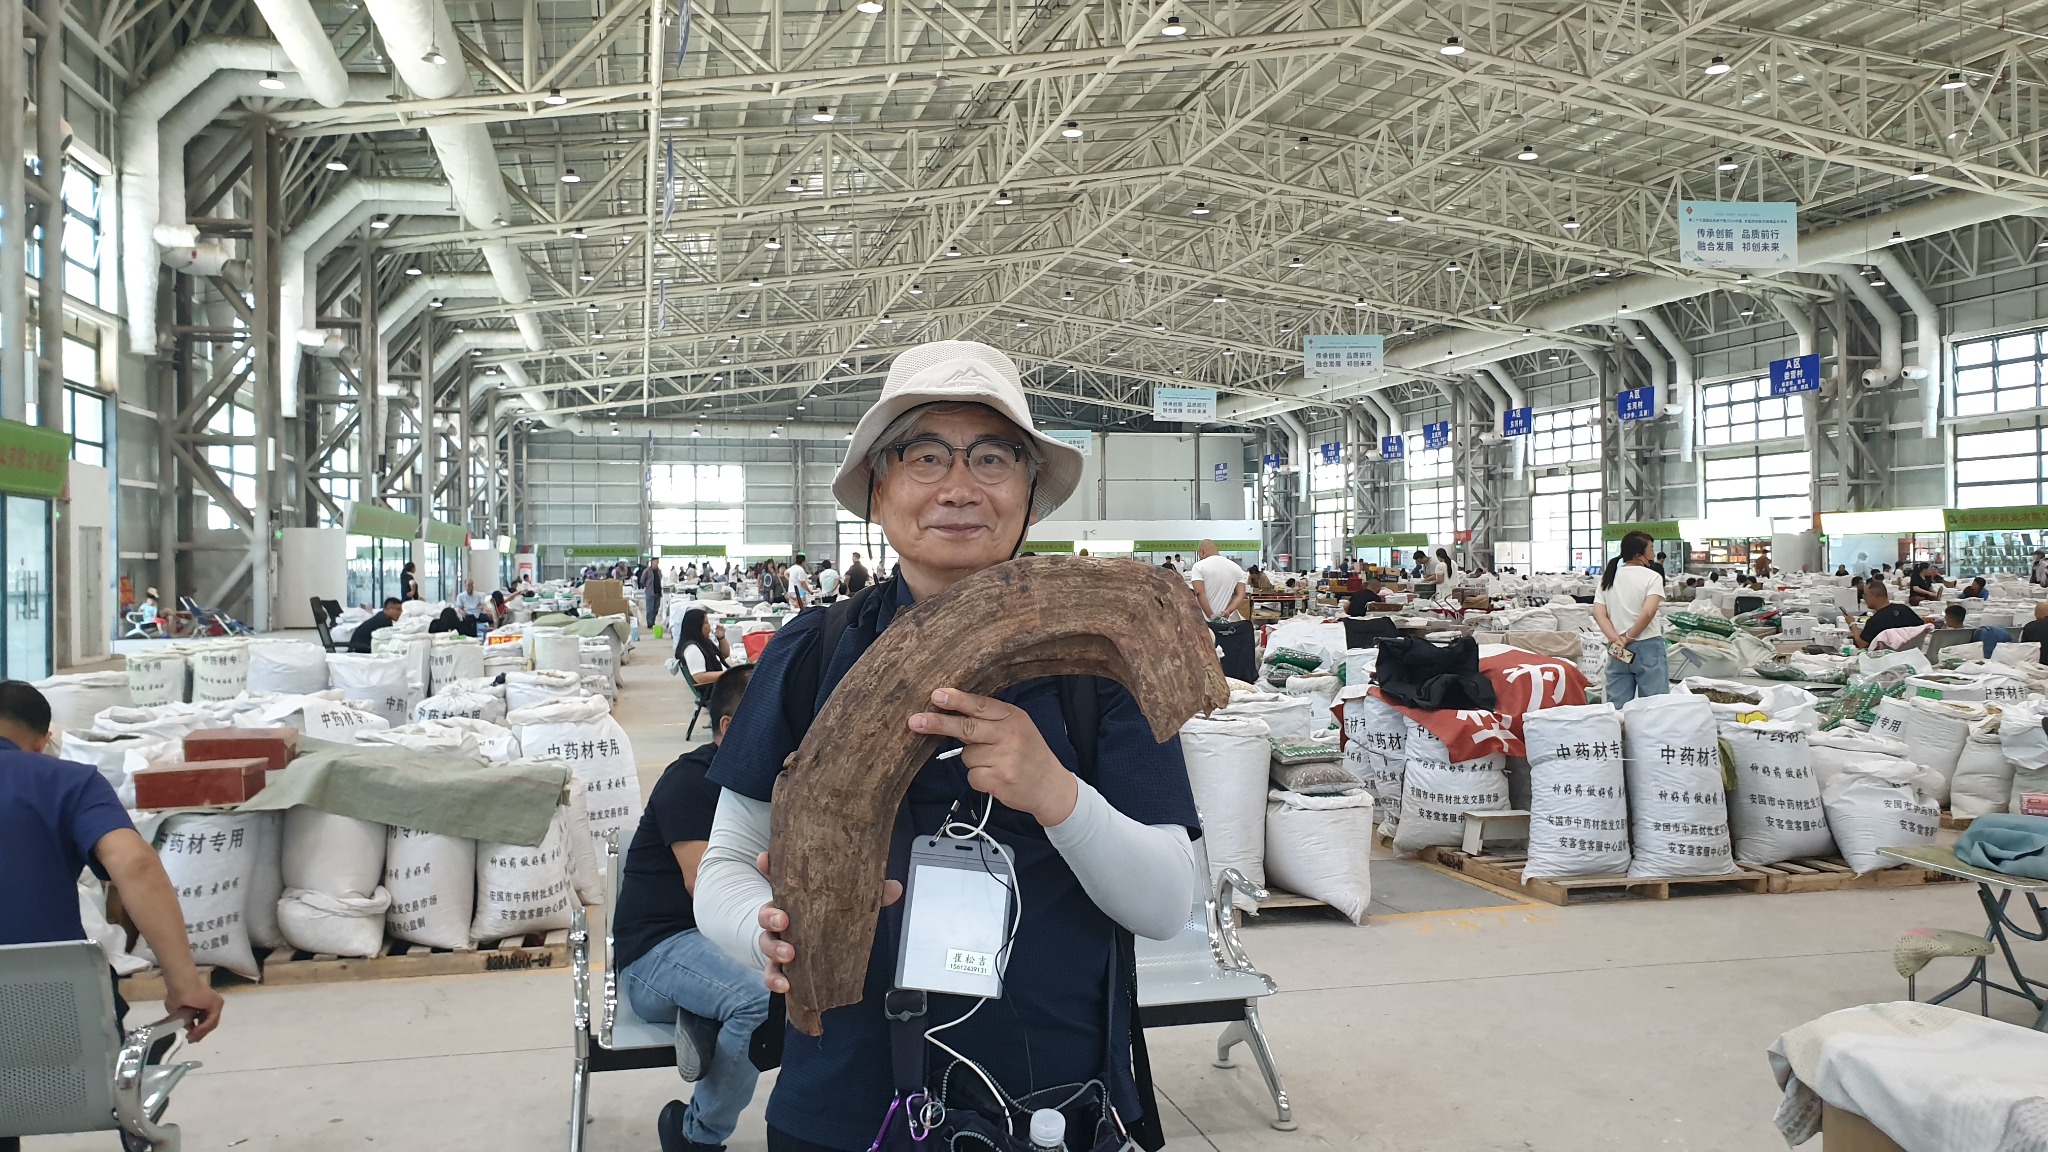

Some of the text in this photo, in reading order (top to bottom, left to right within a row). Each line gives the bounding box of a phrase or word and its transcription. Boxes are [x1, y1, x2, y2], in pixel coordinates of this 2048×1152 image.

[1697, 229, 1780, 239] 传承创新 品质前行
[1697, 241, 1780, 252] 融合发展 祁创未来
[1786, 357, 1800, 369] A区
[1629, 389, 1641, 399] A区
[1511, 409, 1521, 418] A区
[1367, 731, 1408, 751] 中药材
[1556, 741, 1622, 761] 中药材专
[1410, 786, 1499, 805] 安国市中药材批发交易市场
[1552, 782, 1614, 799] 种好药 做好药
[1658, 789, 1690, 804] 种好药
[586, 805, 629, 821] 批发交易市场
[490, 855, 517, 869] 种好药
